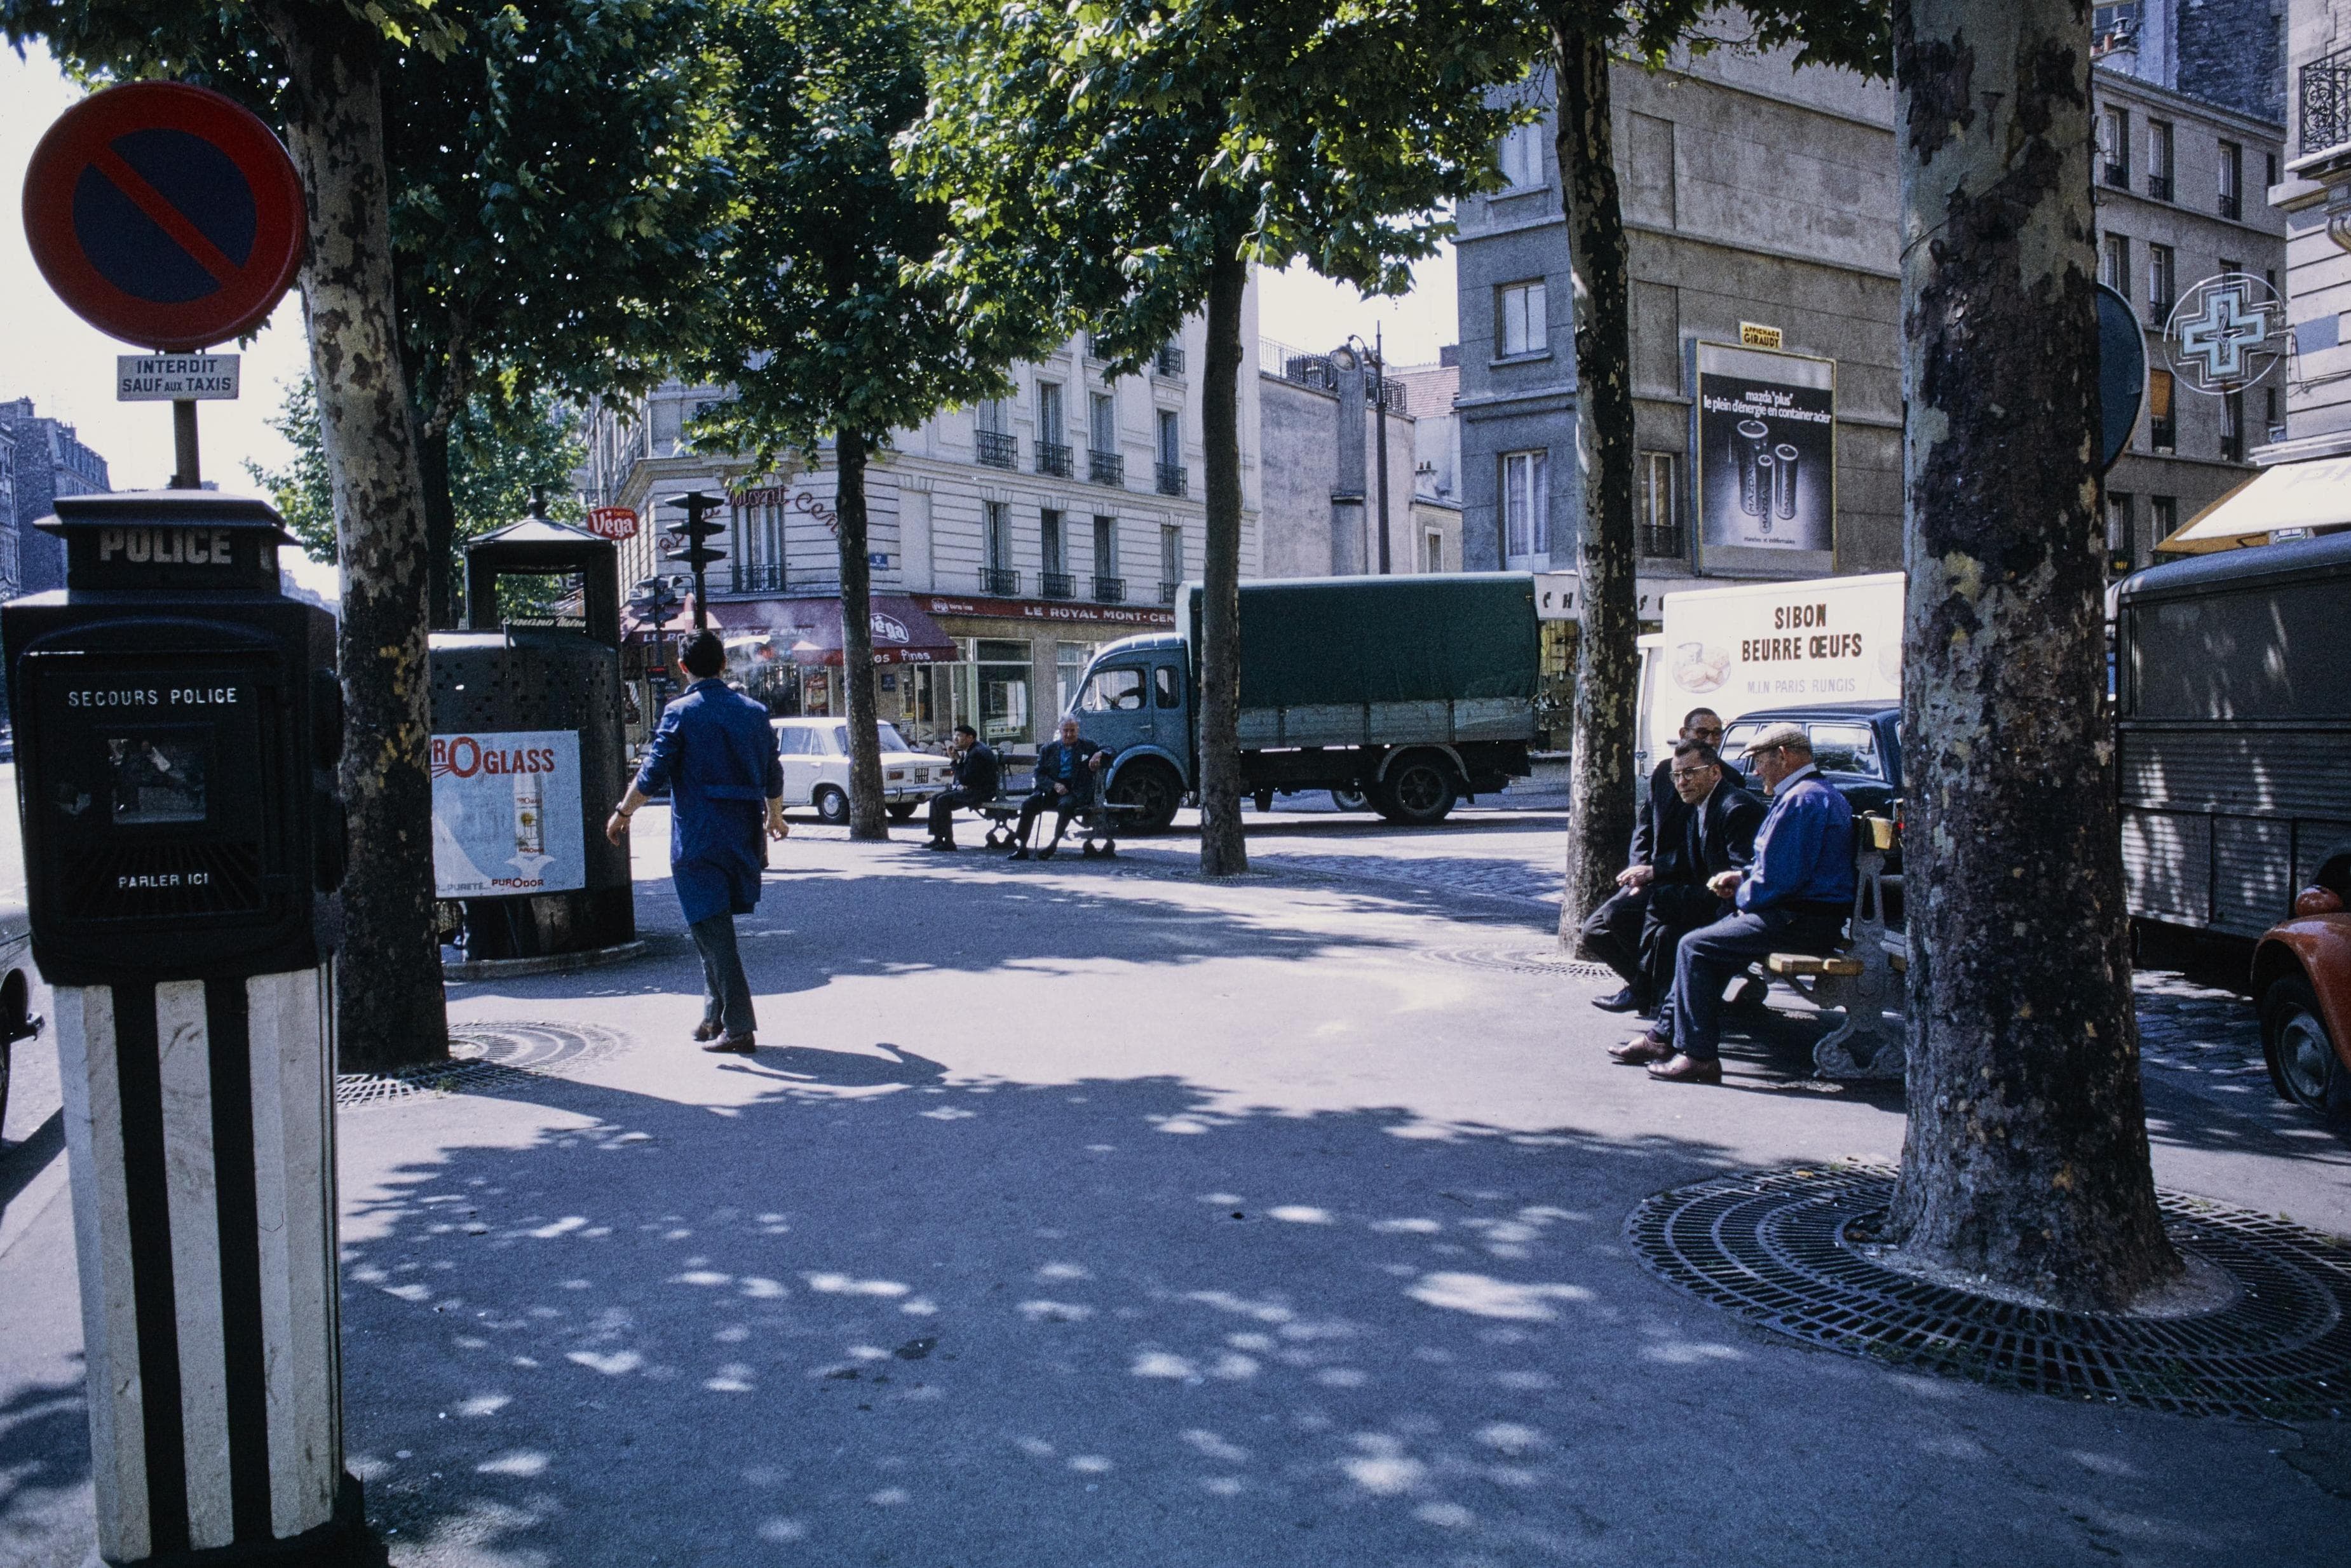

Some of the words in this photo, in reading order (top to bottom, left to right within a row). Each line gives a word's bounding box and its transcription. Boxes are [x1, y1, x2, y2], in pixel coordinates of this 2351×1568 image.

[1744, 333, 1779, 348] GIRAUDY
[137, 360, 217, 374] INTERDIT
[122, 378, 163, 393] SAUF
[164, 381, 183, 392] AUX
[186, 377, 231, 391] TAXIS
[1745, 390, 1772, 403] mazda
[1704, 395, 1712, 409] le
[1712, 396, 1731, 413] plein
[1732, 398, 1766, 418] d'énergie
[1767, 406, 1777, 417] en
[1778, 407, 1813, 421] container
[1813, 410, 1831, 424] acier
[100, 527, 232, 564] POLICE
[1024, 606, 1043, 616] LE
[1050, 608, 1097, 619] ROYAL
[1775, 604, 1826, 630] SIBON
[901, 649, 930, 661] fines
[1742, 637, 1802, 662] BEURRE
[1809, 633, 1862, 659] ŒUFS
[1775, 680, 1805, 693] PARIS
[1813, 678, 1855, 693] RUNGIS
[68, 690, 158, 706] SECOURS
[170, 688, 237, 704] POLICE
[432, 736, 555, 778] ROGLASS
[118, 875, 180, 888] PARLER
[188, 873, 208, 885] ICI
